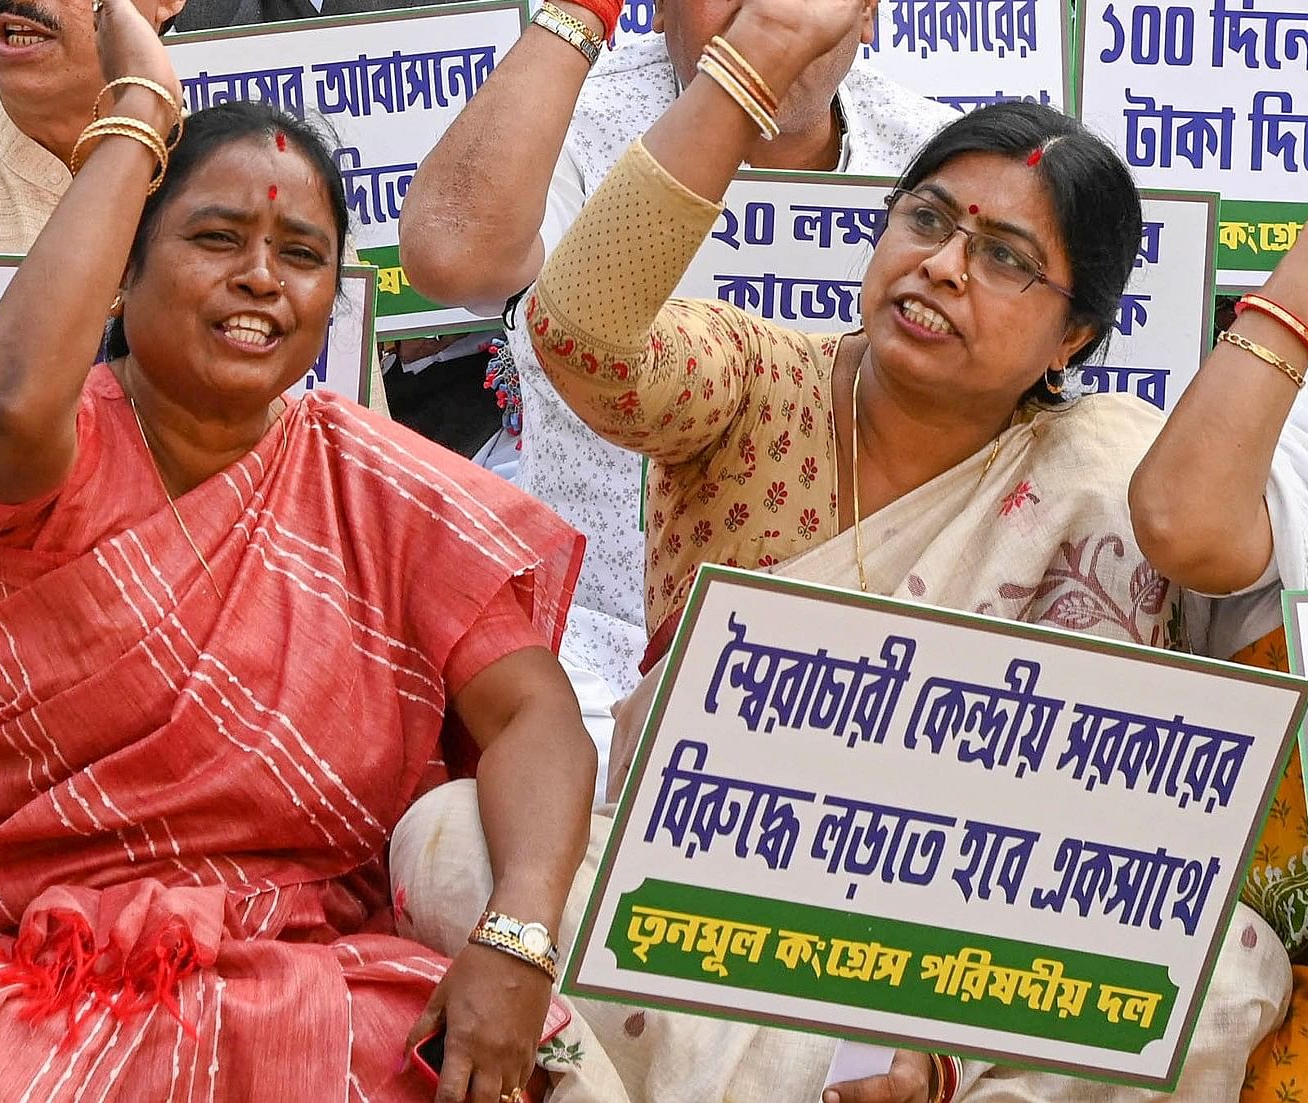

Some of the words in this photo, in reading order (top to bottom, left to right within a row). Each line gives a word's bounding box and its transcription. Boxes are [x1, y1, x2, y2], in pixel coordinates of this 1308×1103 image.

[1098, 4, 1193, 67] ১০০
[1122, 88, 1234, 171] টাকা
[711, 202, 773, 249] ২০
[705, 612, 915, 744] স্বৈরাচারী
[903, 659, 1063, 776] কেন্দ্রীয়
[1058, 703, 1252, 807] সরকারের
[644, 739, 814, 870] বিরুদ্ধে
[810, 795, 955, 900] লড়তে
[951, 820, 1038, 905] হবে
[1030, 838, 1219, 936] একসাথে
[773, 929, 910, 986] কংগ্রেস
[919, 947, 1090, 1018] পরিষদীয়
[1095, 983, 1160, 1028] দল
